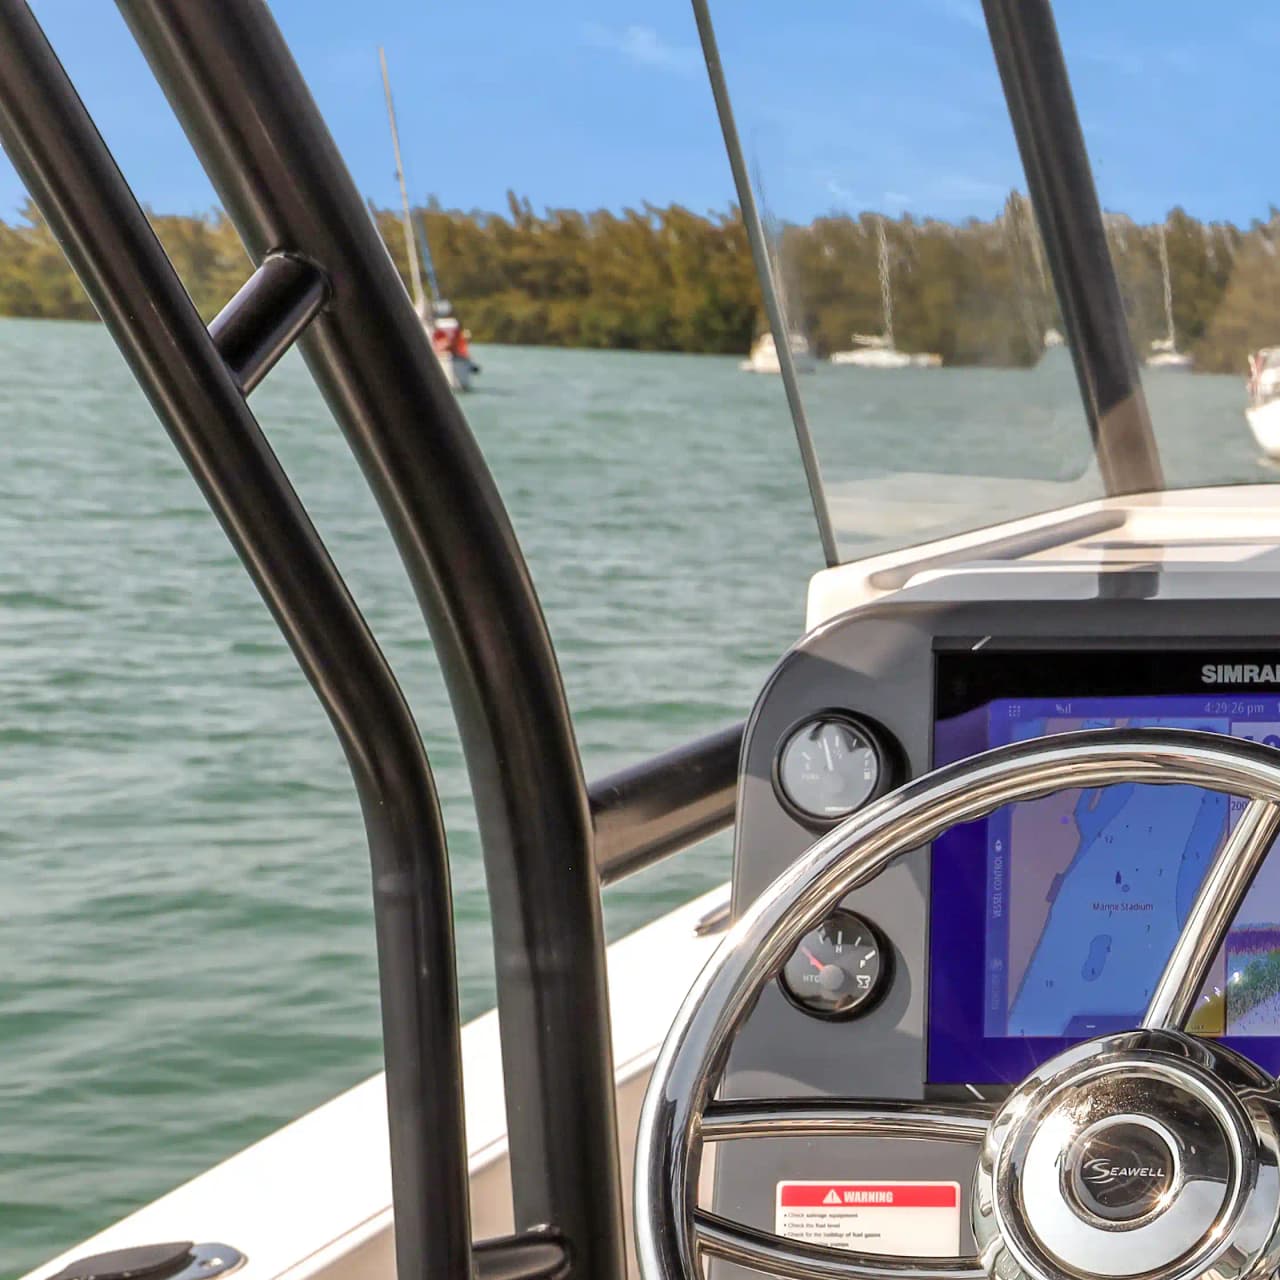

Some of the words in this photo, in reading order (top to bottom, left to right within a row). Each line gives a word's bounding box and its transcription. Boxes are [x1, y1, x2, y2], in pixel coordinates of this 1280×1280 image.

[1204, 702, 1245, 715] 4:29:26
[1247, 704, 1264, 716] pm
[1083, 1158, 1165, 1184] SEAWELL
[844, 1191, 894, 1203] WARNING
